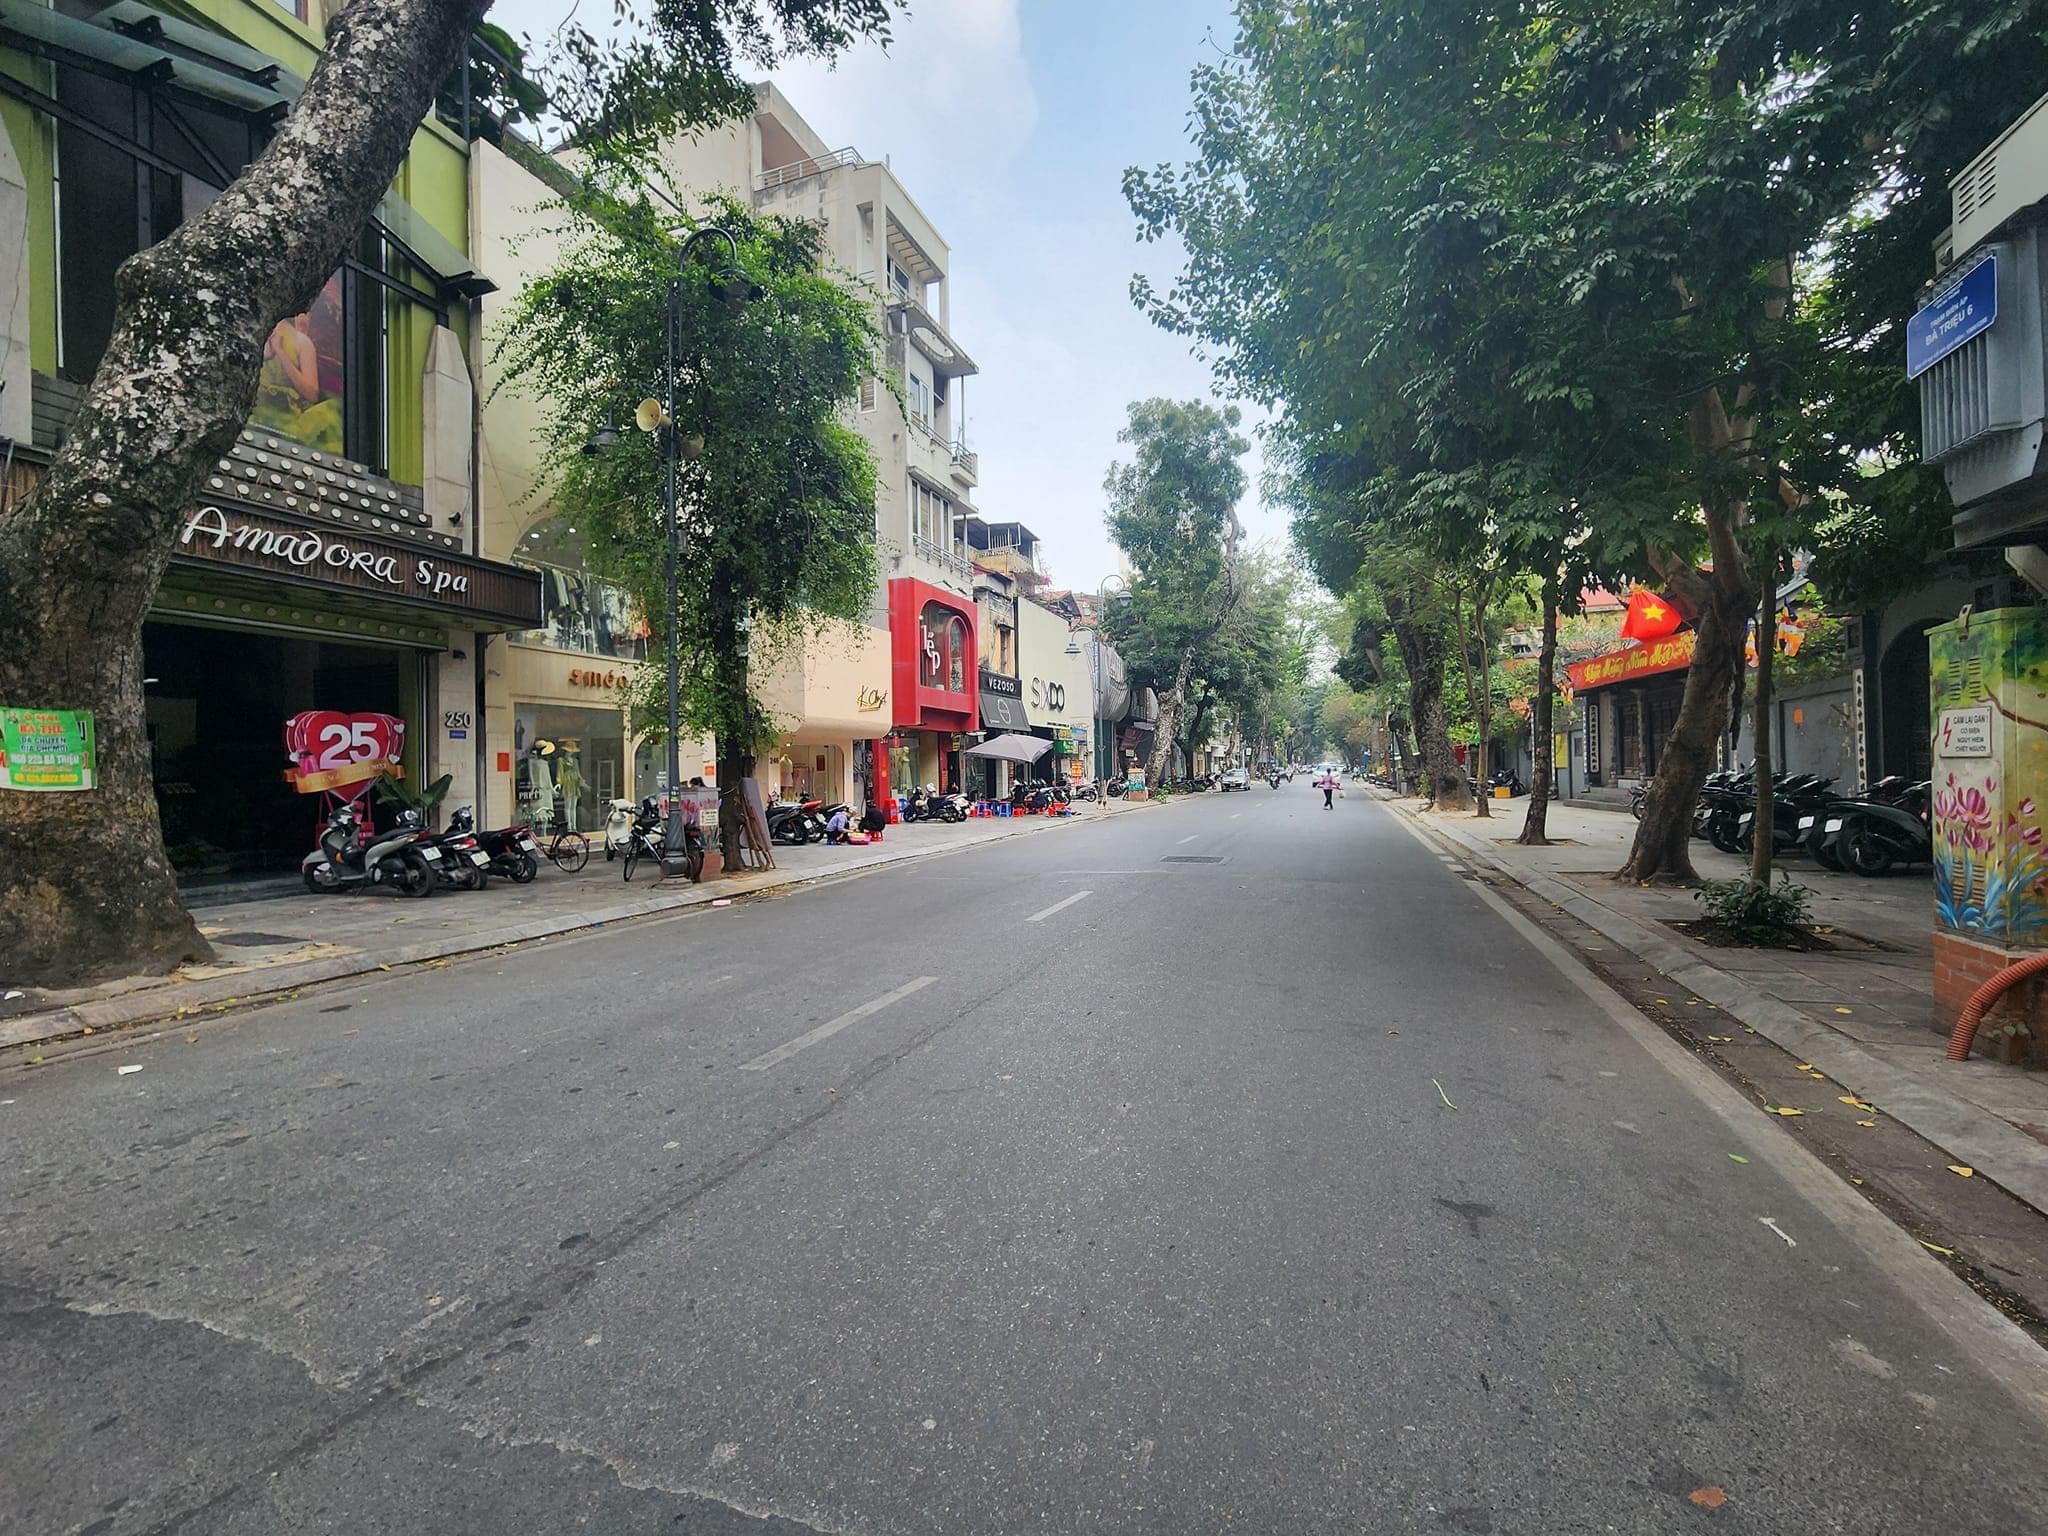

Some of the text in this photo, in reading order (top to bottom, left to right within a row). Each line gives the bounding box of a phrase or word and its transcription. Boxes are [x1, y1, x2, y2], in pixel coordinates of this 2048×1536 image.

[1925, 304, 1974, 346] BÀ TRIỆU 6
[415, 559, 468, 593] Spa
[1031, 676, 1065, 712] SIXDO
[445, 711, 472, 728] 250
[320, 722, 379, 769] 25
